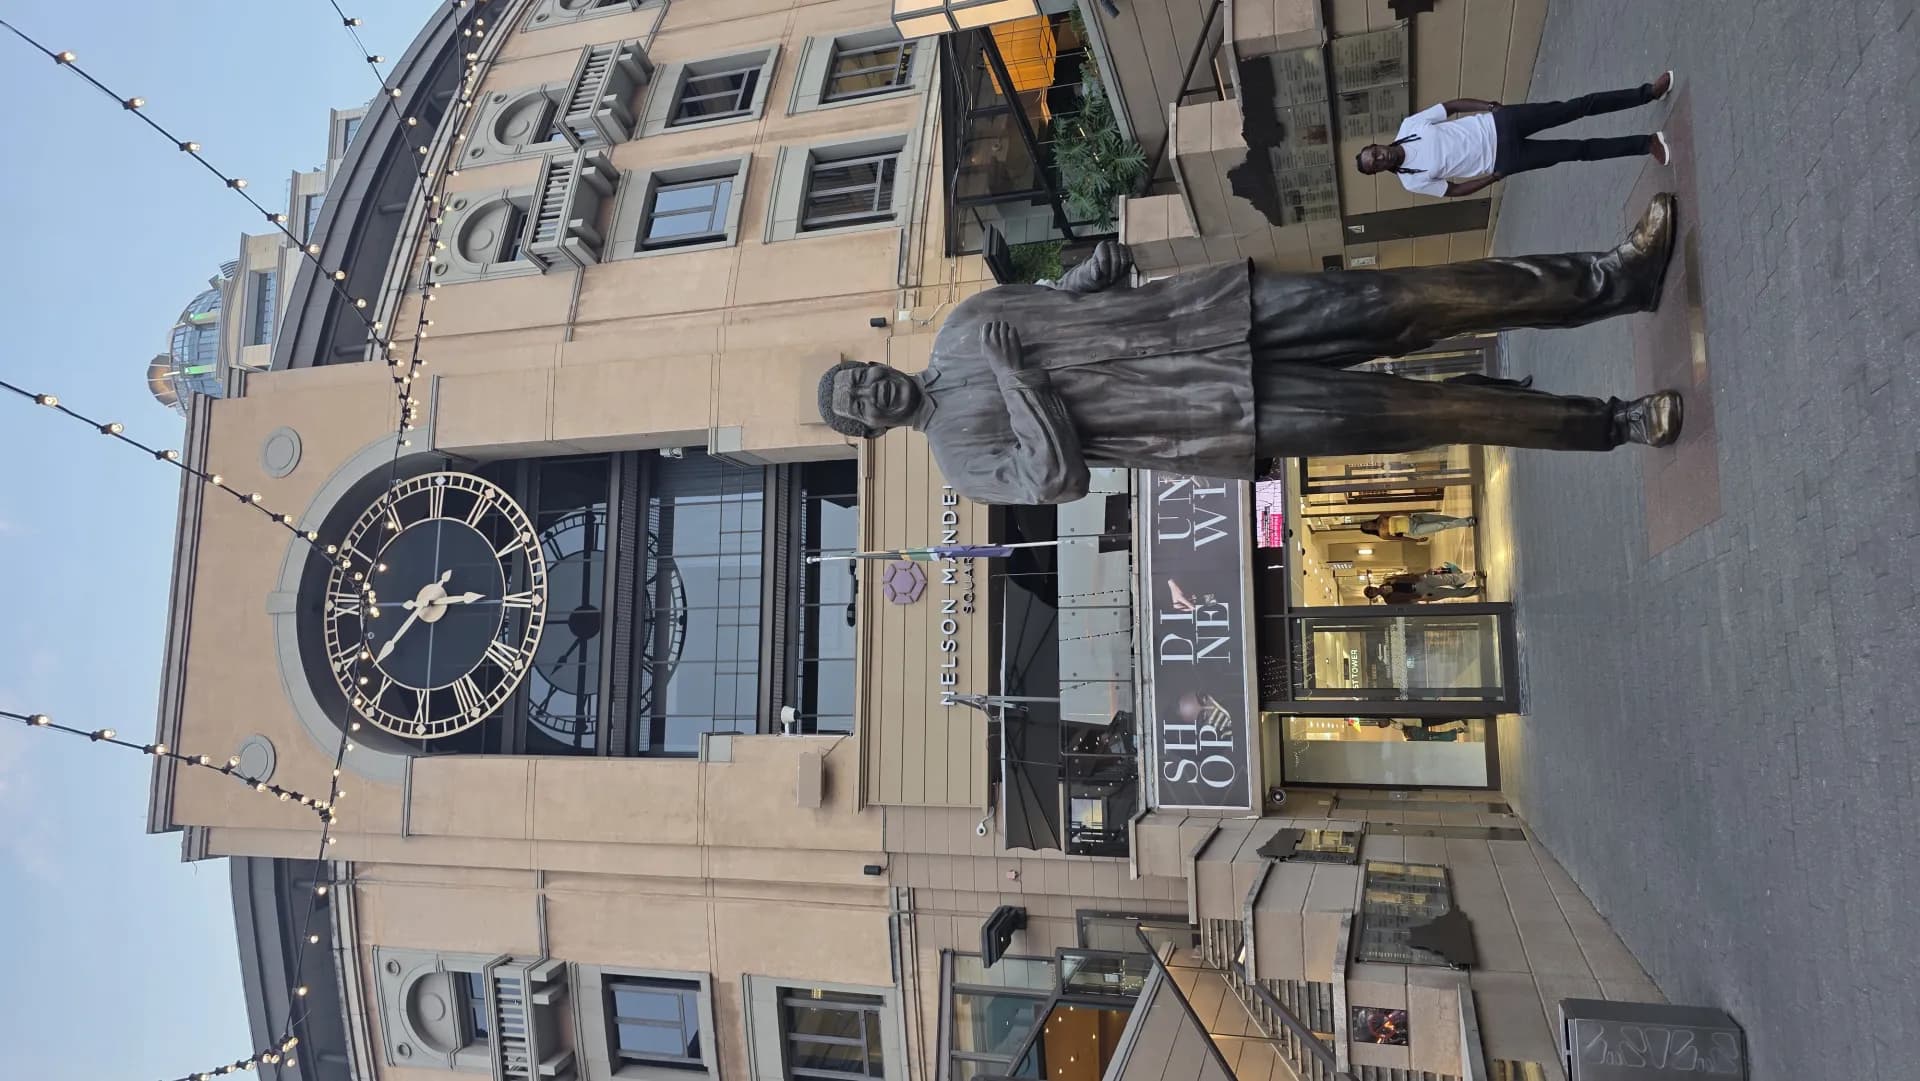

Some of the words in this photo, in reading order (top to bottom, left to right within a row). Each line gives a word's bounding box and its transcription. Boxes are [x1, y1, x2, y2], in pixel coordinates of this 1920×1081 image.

[940, 485, 958, 584] MNDE
[1157, 475, 1192, 545] UN
[962, 556, 974, 614] SQUAR
[939, 599, 957, 706] NELSON
[1160, 608, 1194, 666] DI
[1195, 602, 1231, 664] NE
[1350, 649, 1358, 678] TOWER
[1162, 720, 1199, 784] SH
[1198, 724, 1236, 788] OP
